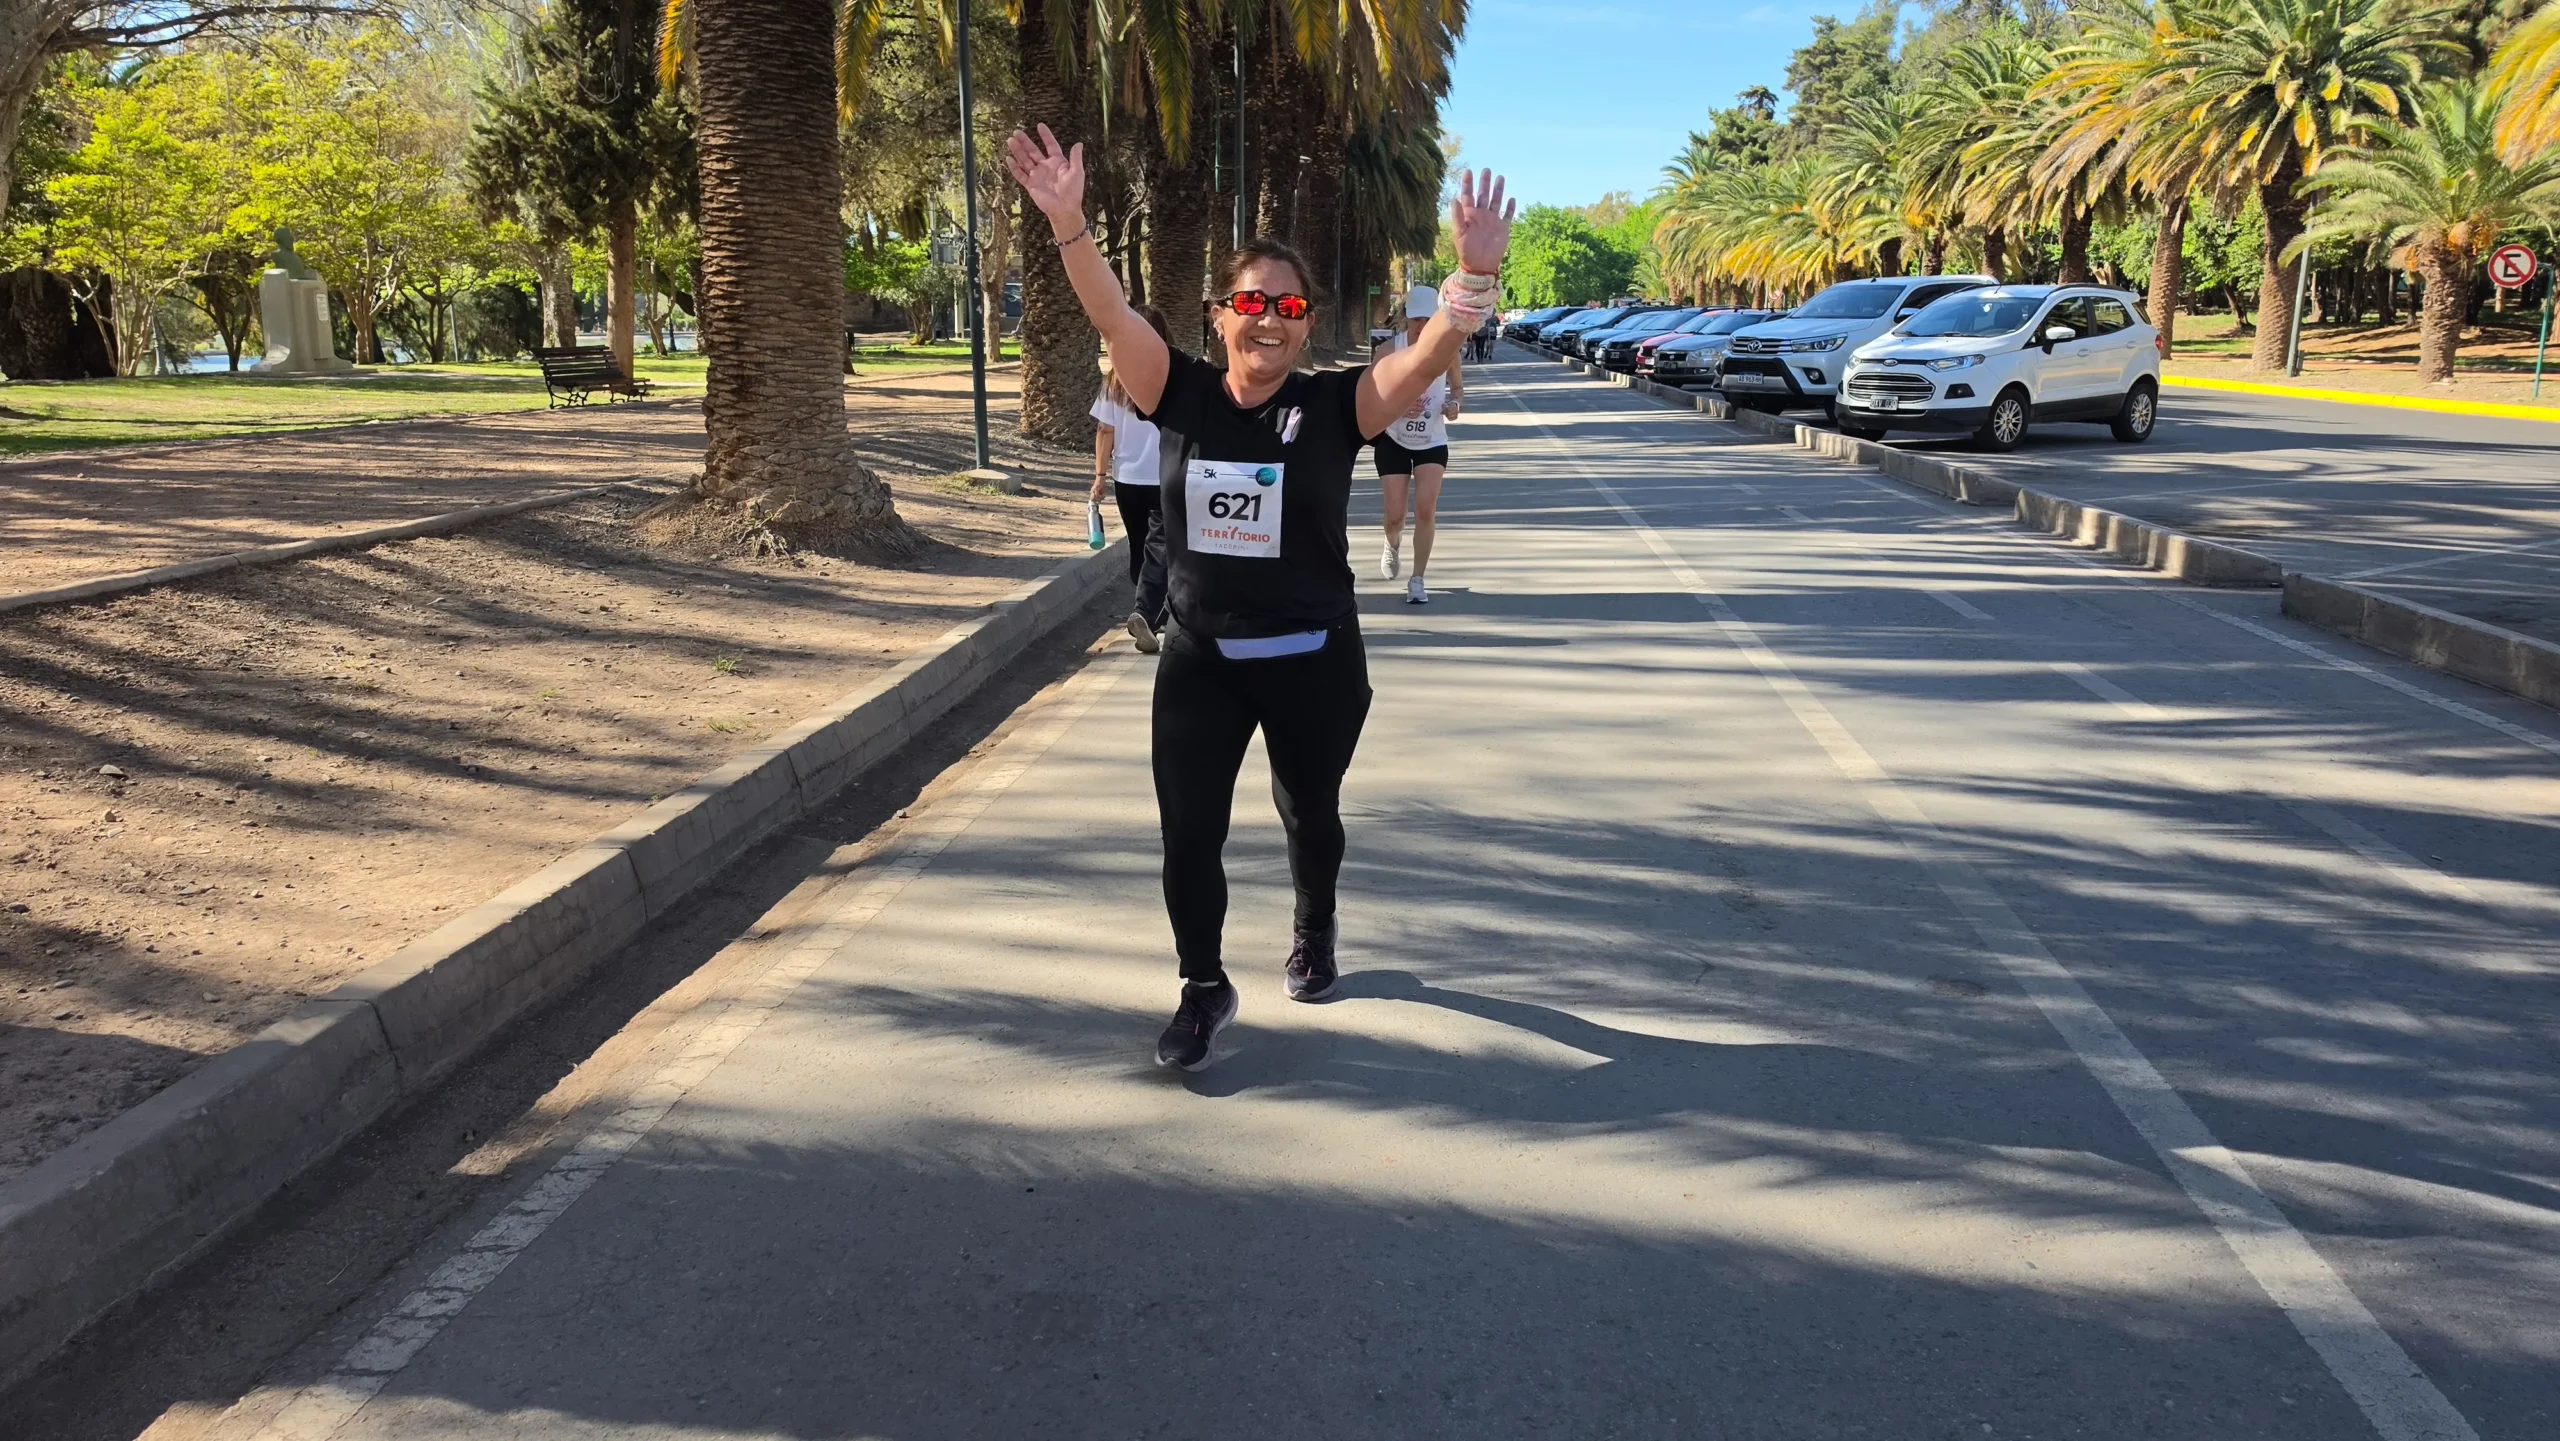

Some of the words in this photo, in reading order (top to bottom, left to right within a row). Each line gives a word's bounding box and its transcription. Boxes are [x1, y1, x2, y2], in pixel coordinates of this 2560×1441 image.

[1406, 420, 1426, 432] 618
[1203, 468, 1217, 479] 5k
[1208, 492, 1262, 522] 621
[1201, 525, 1271, 543] TERRITORIO
